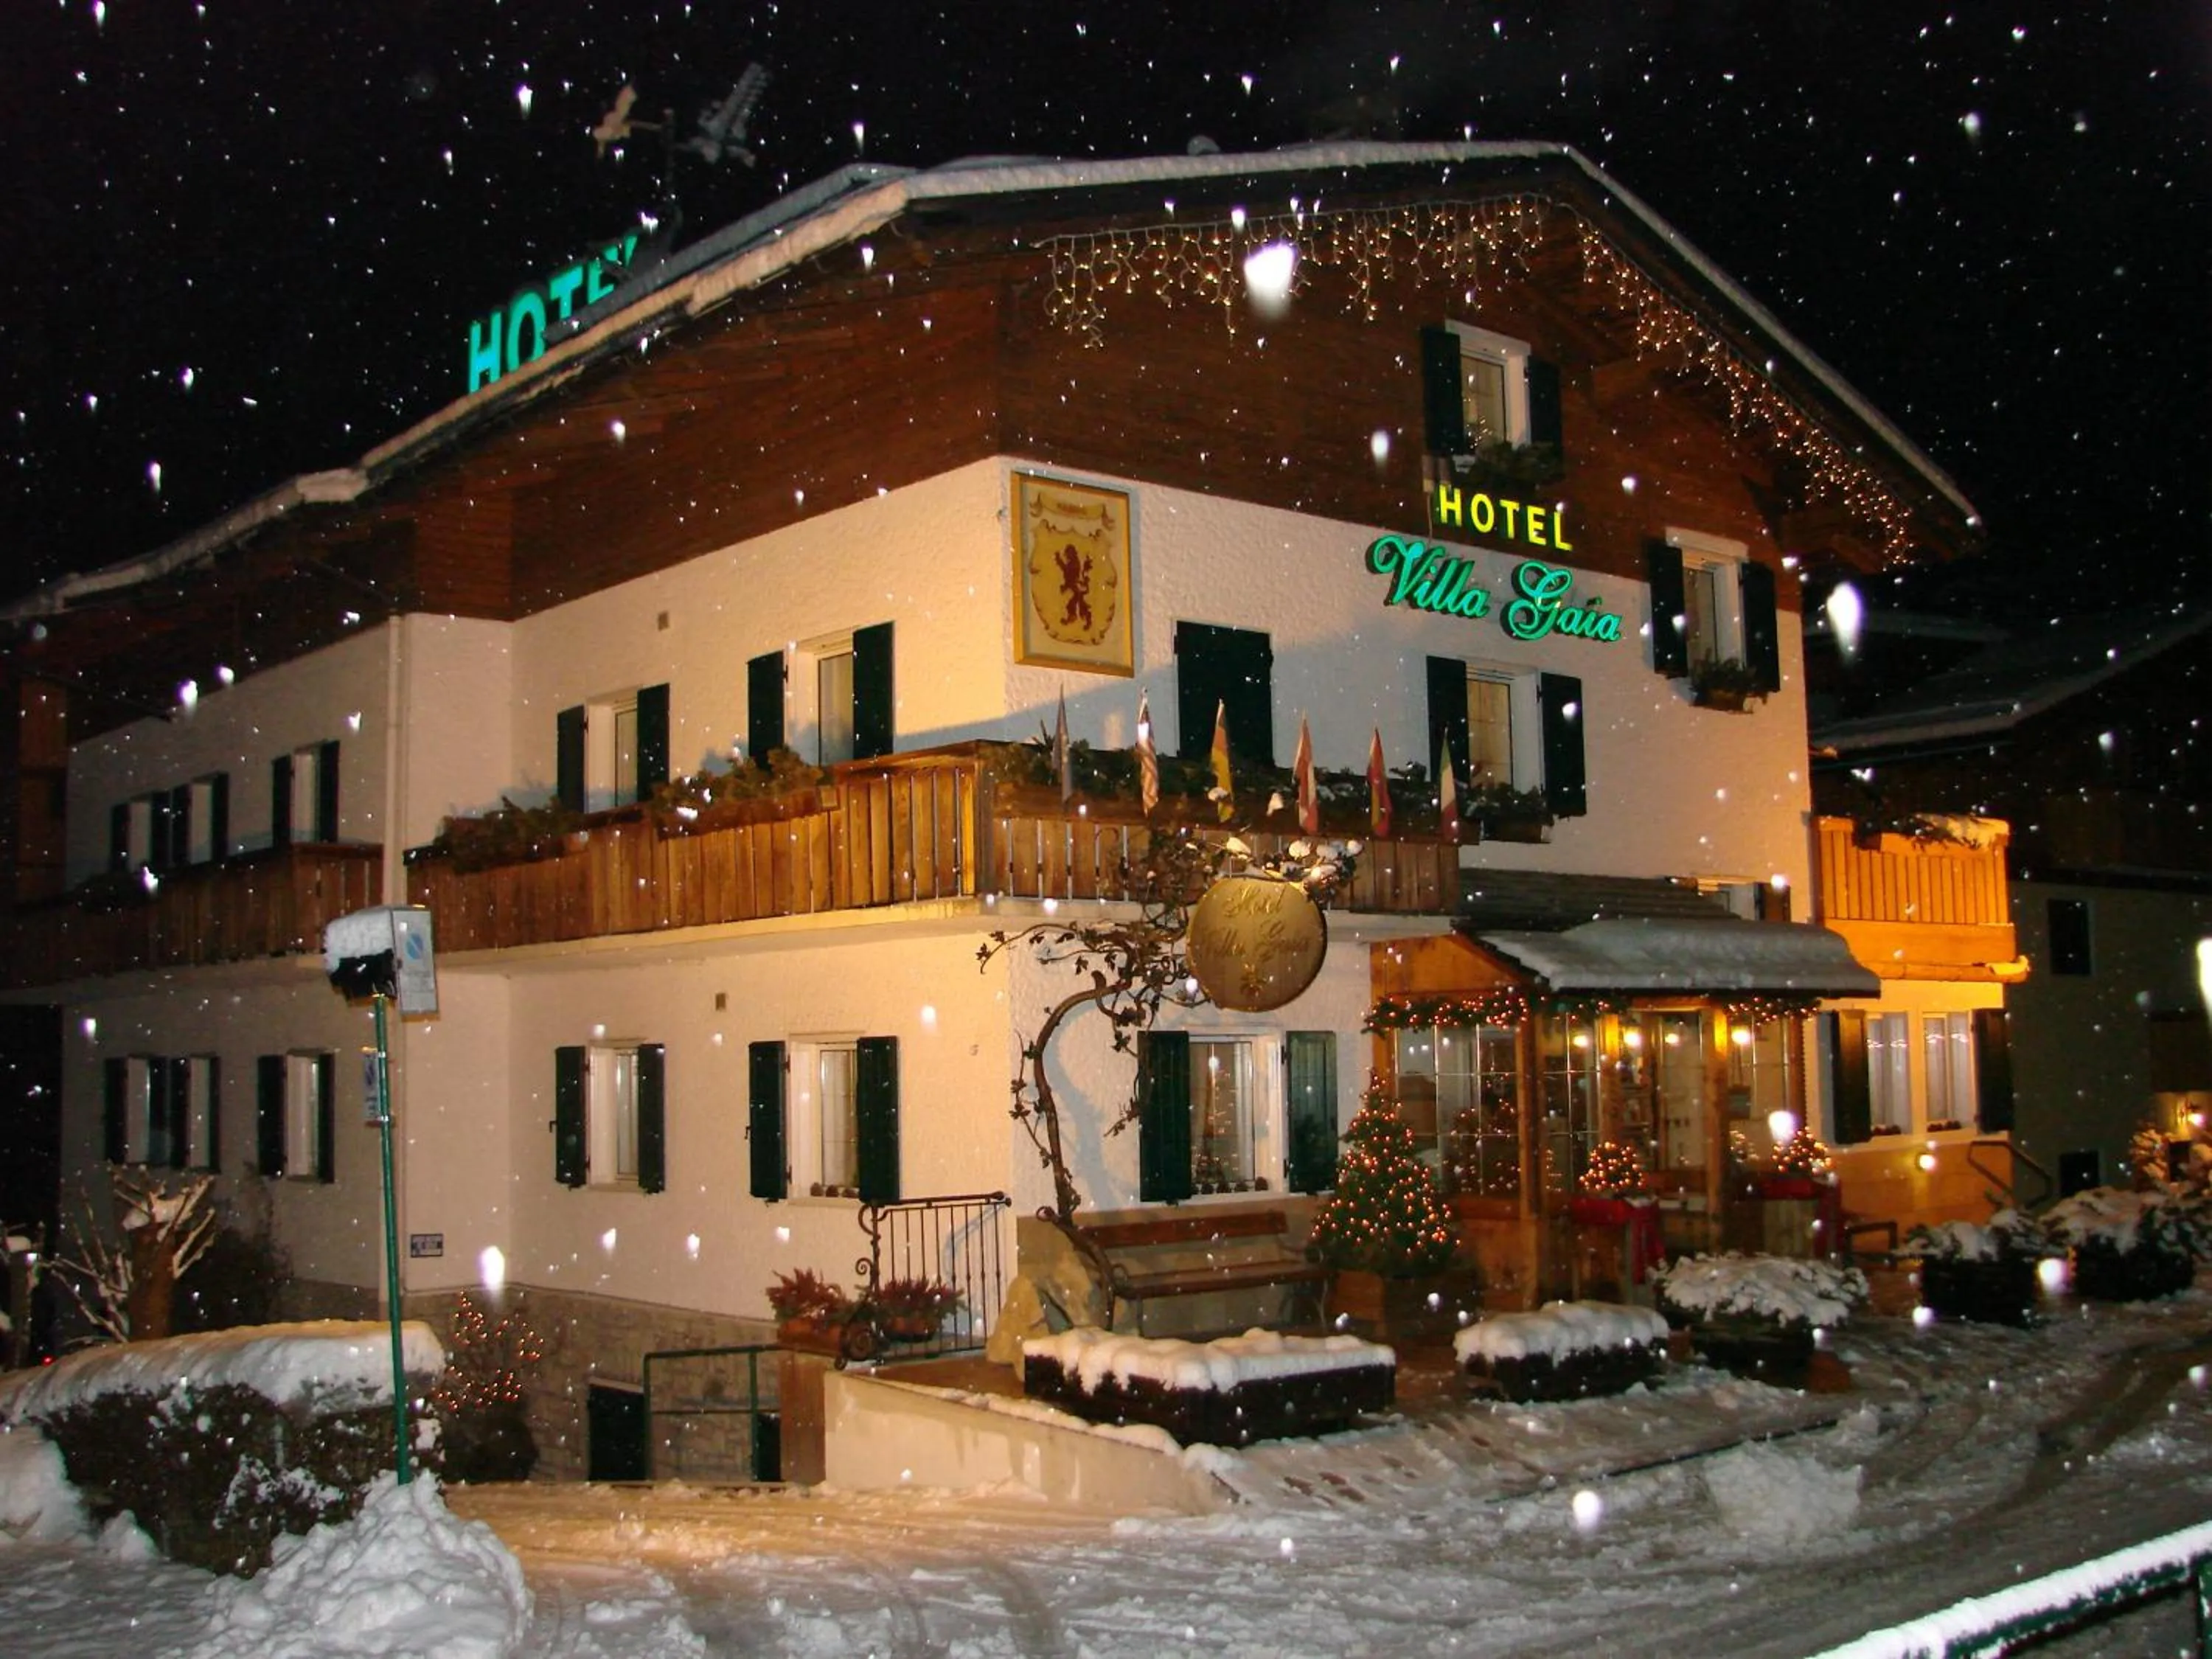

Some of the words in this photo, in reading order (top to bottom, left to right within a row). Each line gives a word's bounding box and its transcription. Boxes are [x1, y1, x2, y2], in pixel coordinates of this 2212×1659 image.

[1438, 483, 1573, 552] HOTEL
[1366, 535, 1490, 618] Villa
[1501, 560, 1623, 642] Gaia
